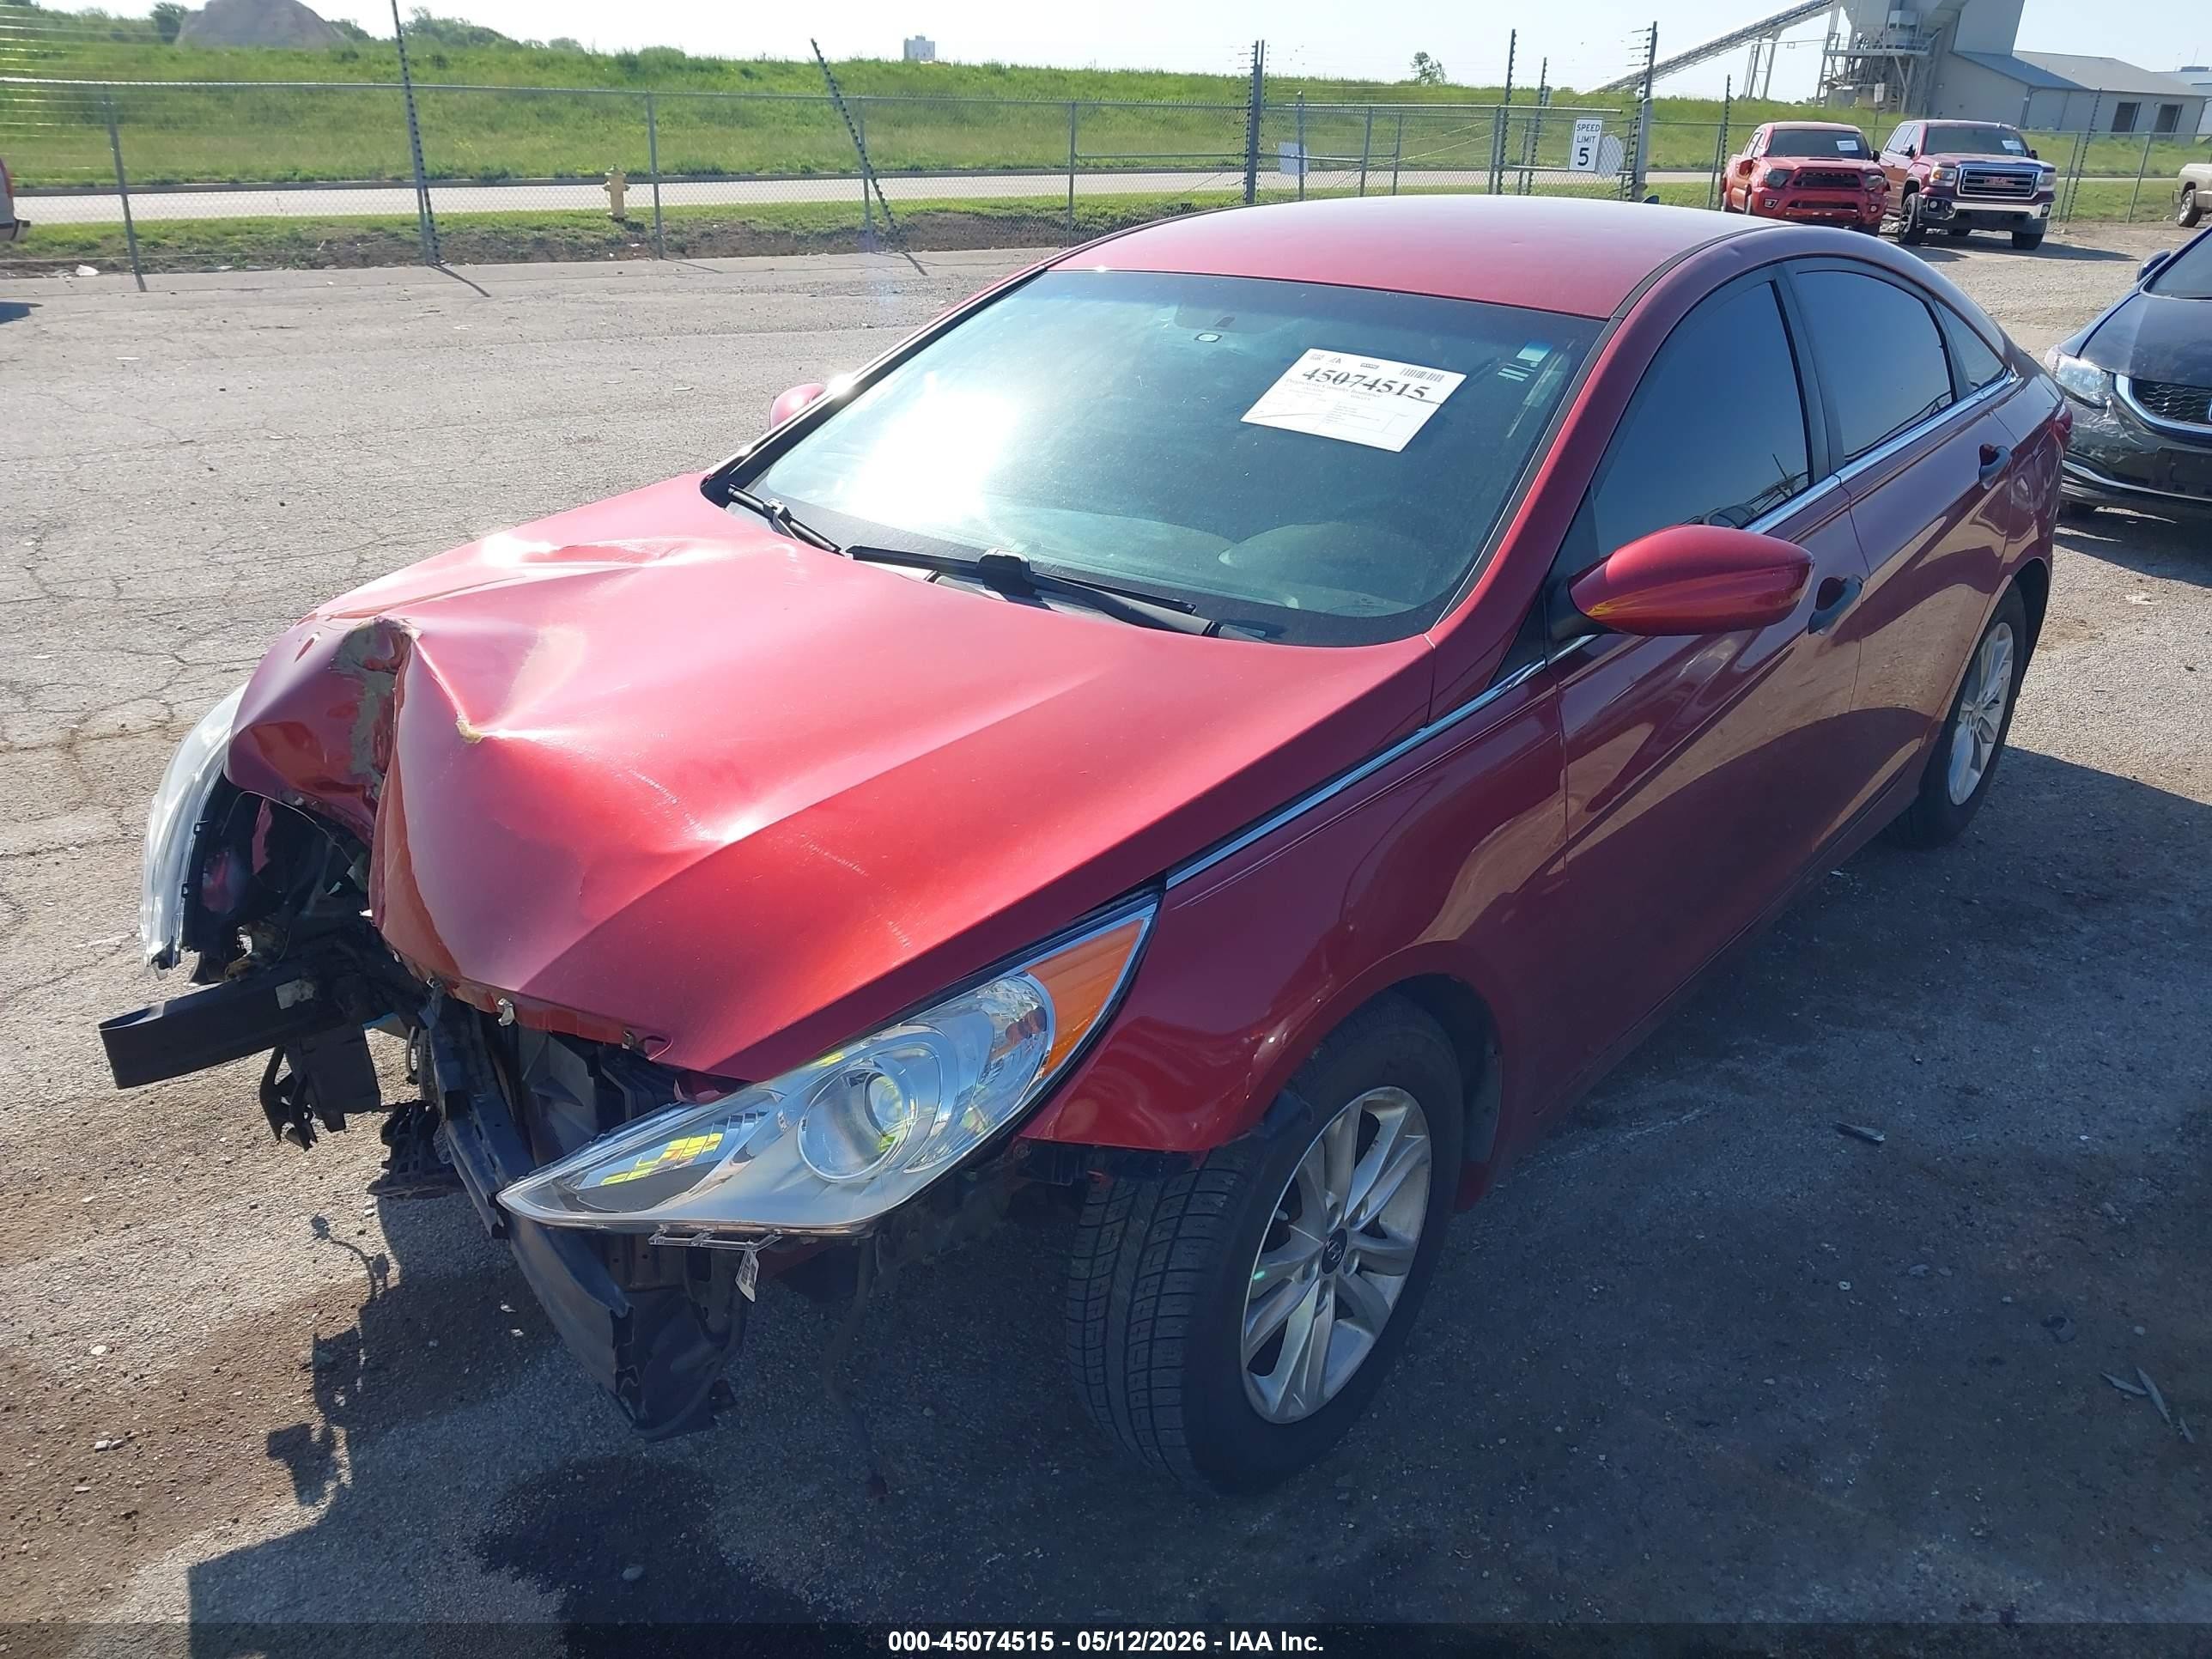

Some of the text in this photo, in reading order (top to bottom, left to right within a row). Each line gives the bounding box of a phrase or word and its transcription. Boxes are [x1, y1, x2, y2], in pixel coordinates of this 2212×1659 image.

[1577, 124, 1601, 132] SPEED
[1577, 147, 1589, 167] 5
[1302, 368, 1431, 399] 45074515
